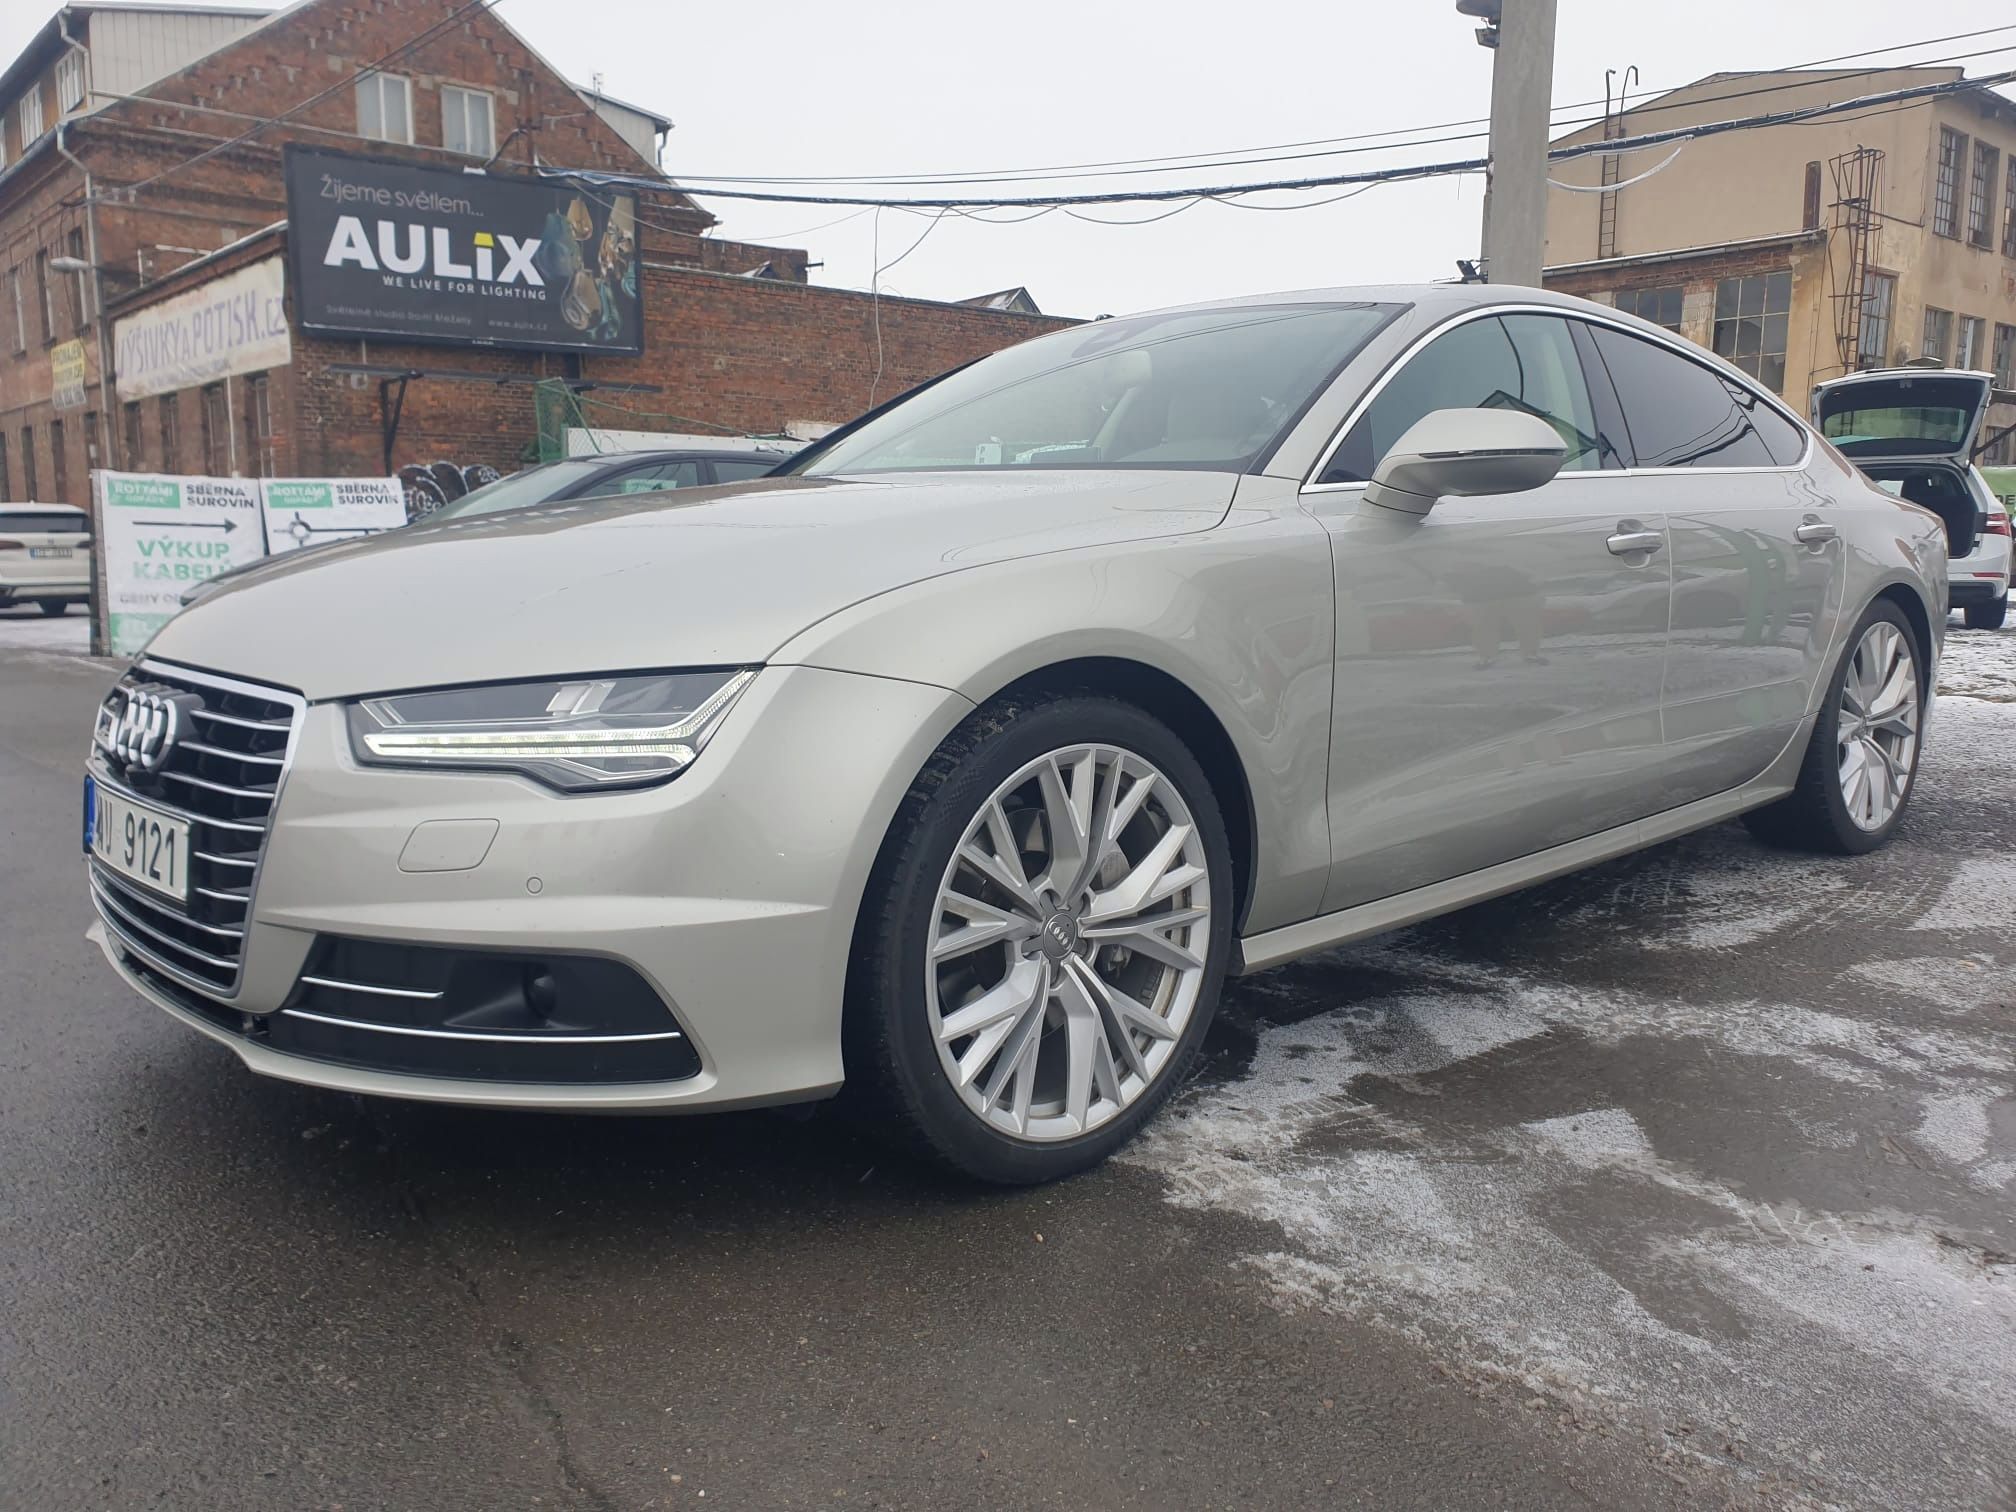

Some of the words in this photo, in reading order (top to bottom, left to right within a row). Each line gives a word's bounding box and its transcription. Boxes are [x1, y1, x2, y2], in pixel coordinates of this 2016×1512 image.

[320, 173, 392, 205] Žijeme
[382, 274, 403, 288] WE
[410, 277, 441, 291] LIVE
[448, 281, 475, 294] FOR
[481, 285, 546, 301] LIGHTING
[187, 496, 254, 508] SUROVIN
[338, 494, 399, 505] SUROVIN
[136, 535, 230, 559] VÝKUP
[125, 811, 175, 888] 9121
